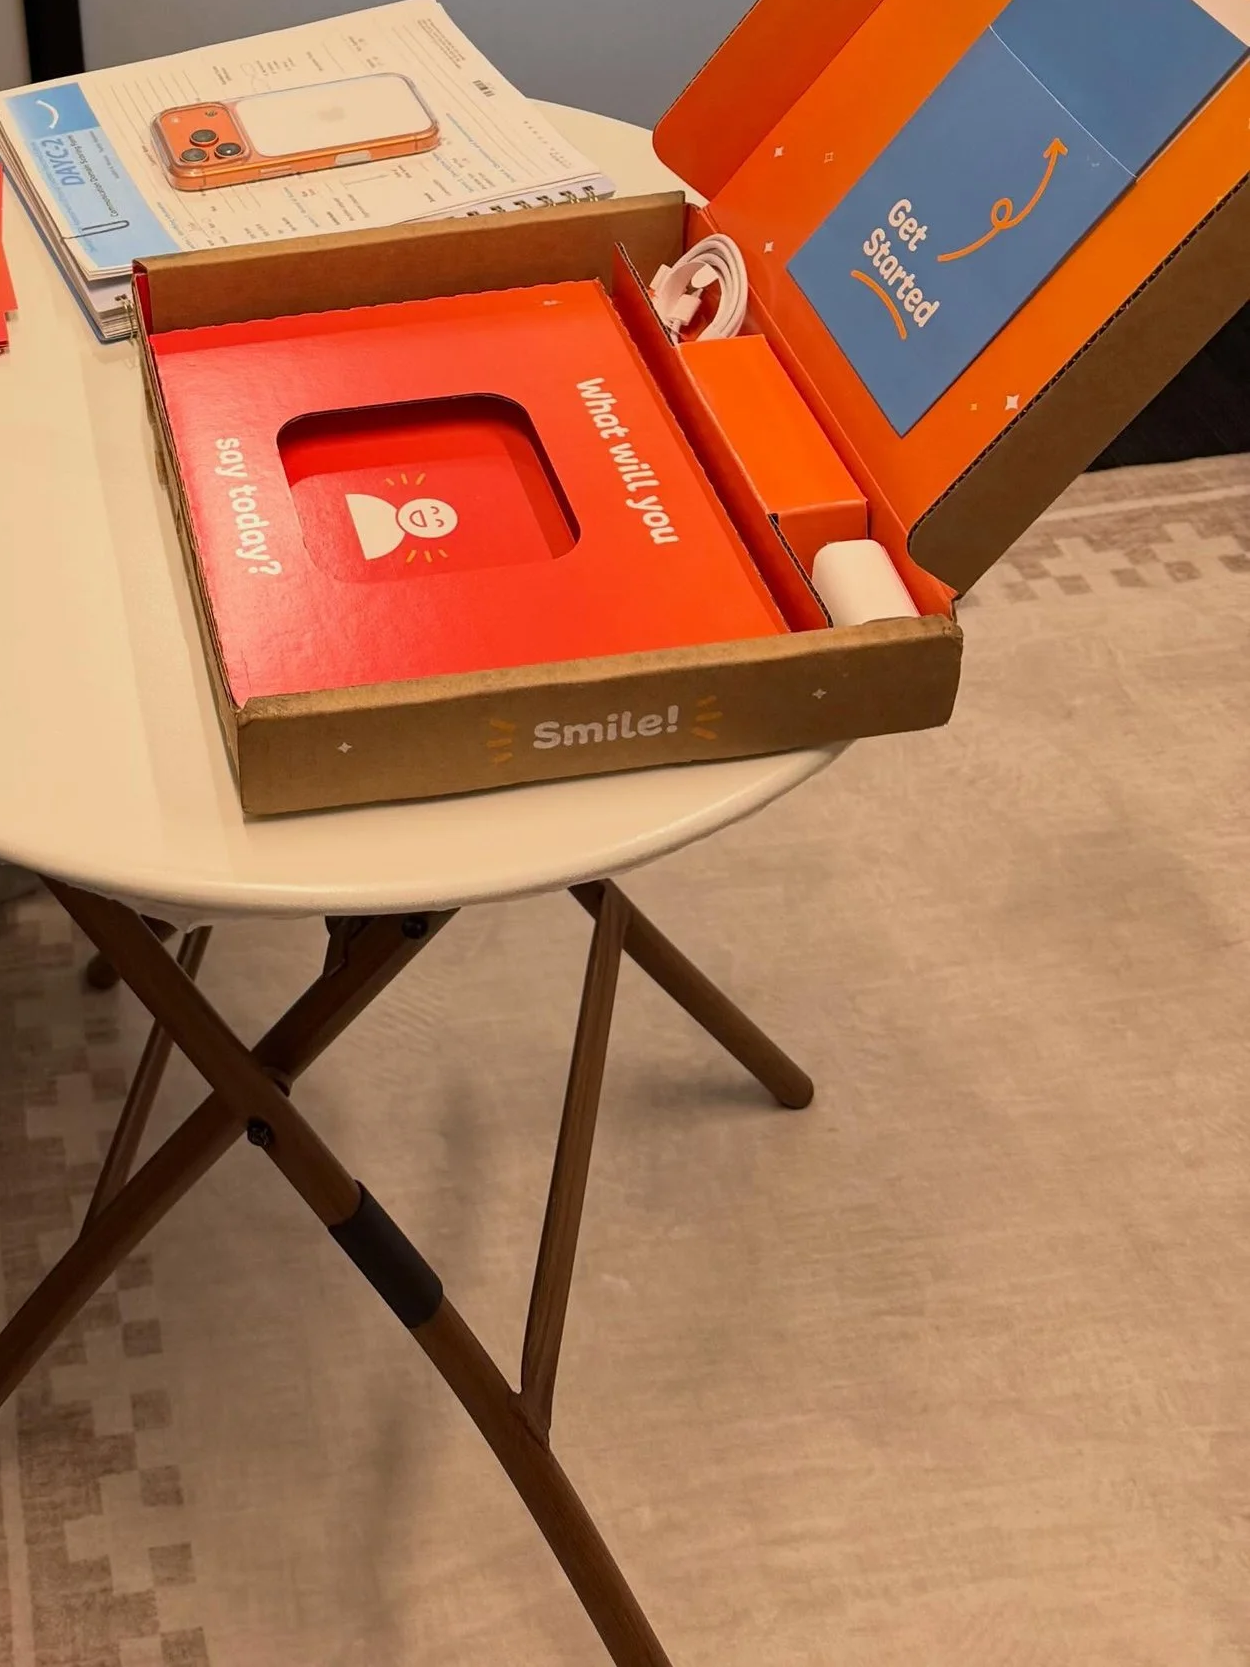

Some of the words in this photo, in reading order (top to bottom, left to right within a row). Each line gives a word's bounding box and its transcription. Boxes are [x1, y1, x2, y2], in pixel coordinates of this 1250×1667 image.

[38, 137, 85, 187] DAYC-2
[65, 134, 78, 146] Form
[71, 145, 90, 164] Scoring
[82, 164, 98, 182] Domain
[92, 181, 118, 217] Communication
[888, 198, 928, 252] Get
[863, 228, 940, 328] Started
[576, 377, 630, 439] What
[215, 438, 248, 477] say
[609, 443, 660, 492] will
[228, 485, 282, 575] today?
[626, 495, 679, 544] you
[533, 705, 679, 749] Smile!
